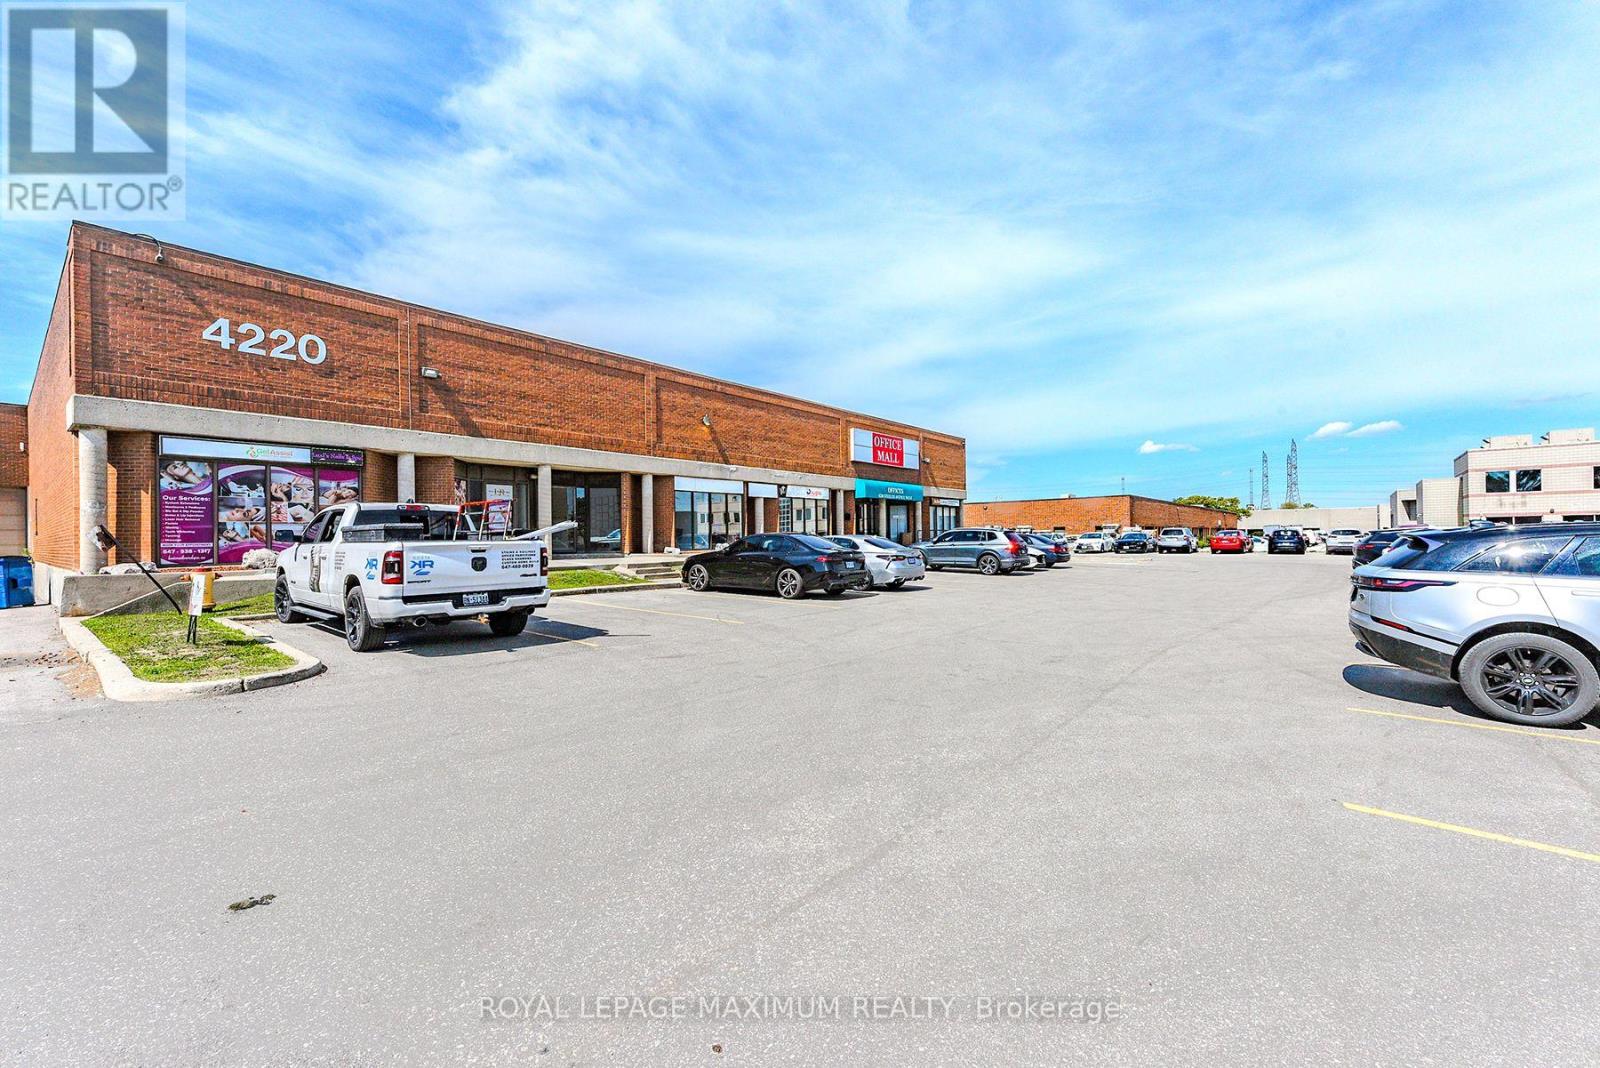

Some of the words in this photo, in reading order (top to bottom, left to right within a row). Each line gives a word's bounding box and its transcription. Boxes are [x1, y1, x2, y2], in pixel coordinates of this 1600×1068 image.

[202, 317, 327, 365] 4220
[874, 436, 902, 450] OFFICE
[877, 450, 900, 464] MALL
